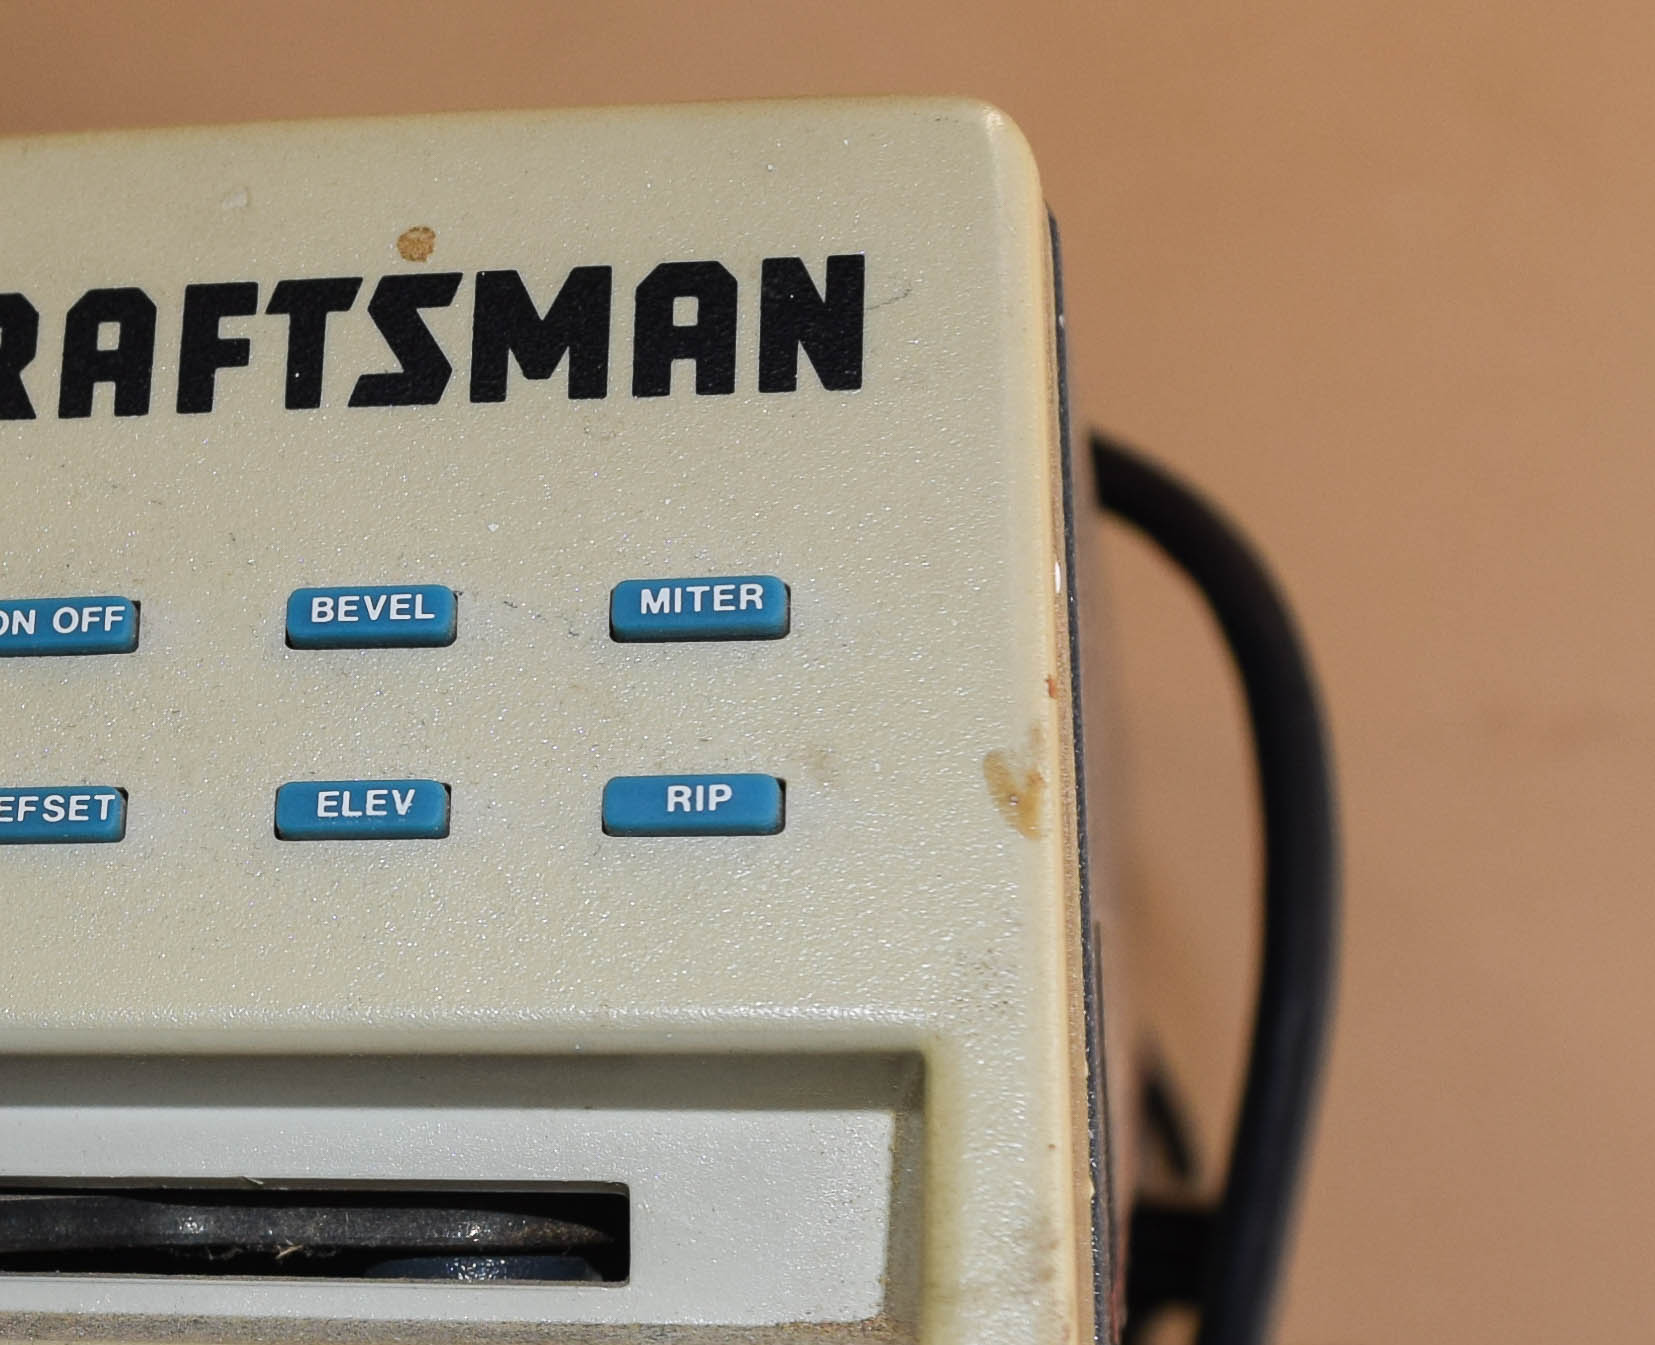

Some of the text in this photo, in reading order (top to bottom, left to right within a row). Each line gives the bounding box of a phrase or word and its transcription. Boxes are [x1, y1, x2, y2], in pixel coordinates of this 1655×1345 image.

[310, 592, 436, 624] BEVEL
[639, 583, 765, 616] MITER
[52, 605, 125, 635] OFF
[316, 788, 417, 819] ELEV
[665, 783, 734, 814] RIP
